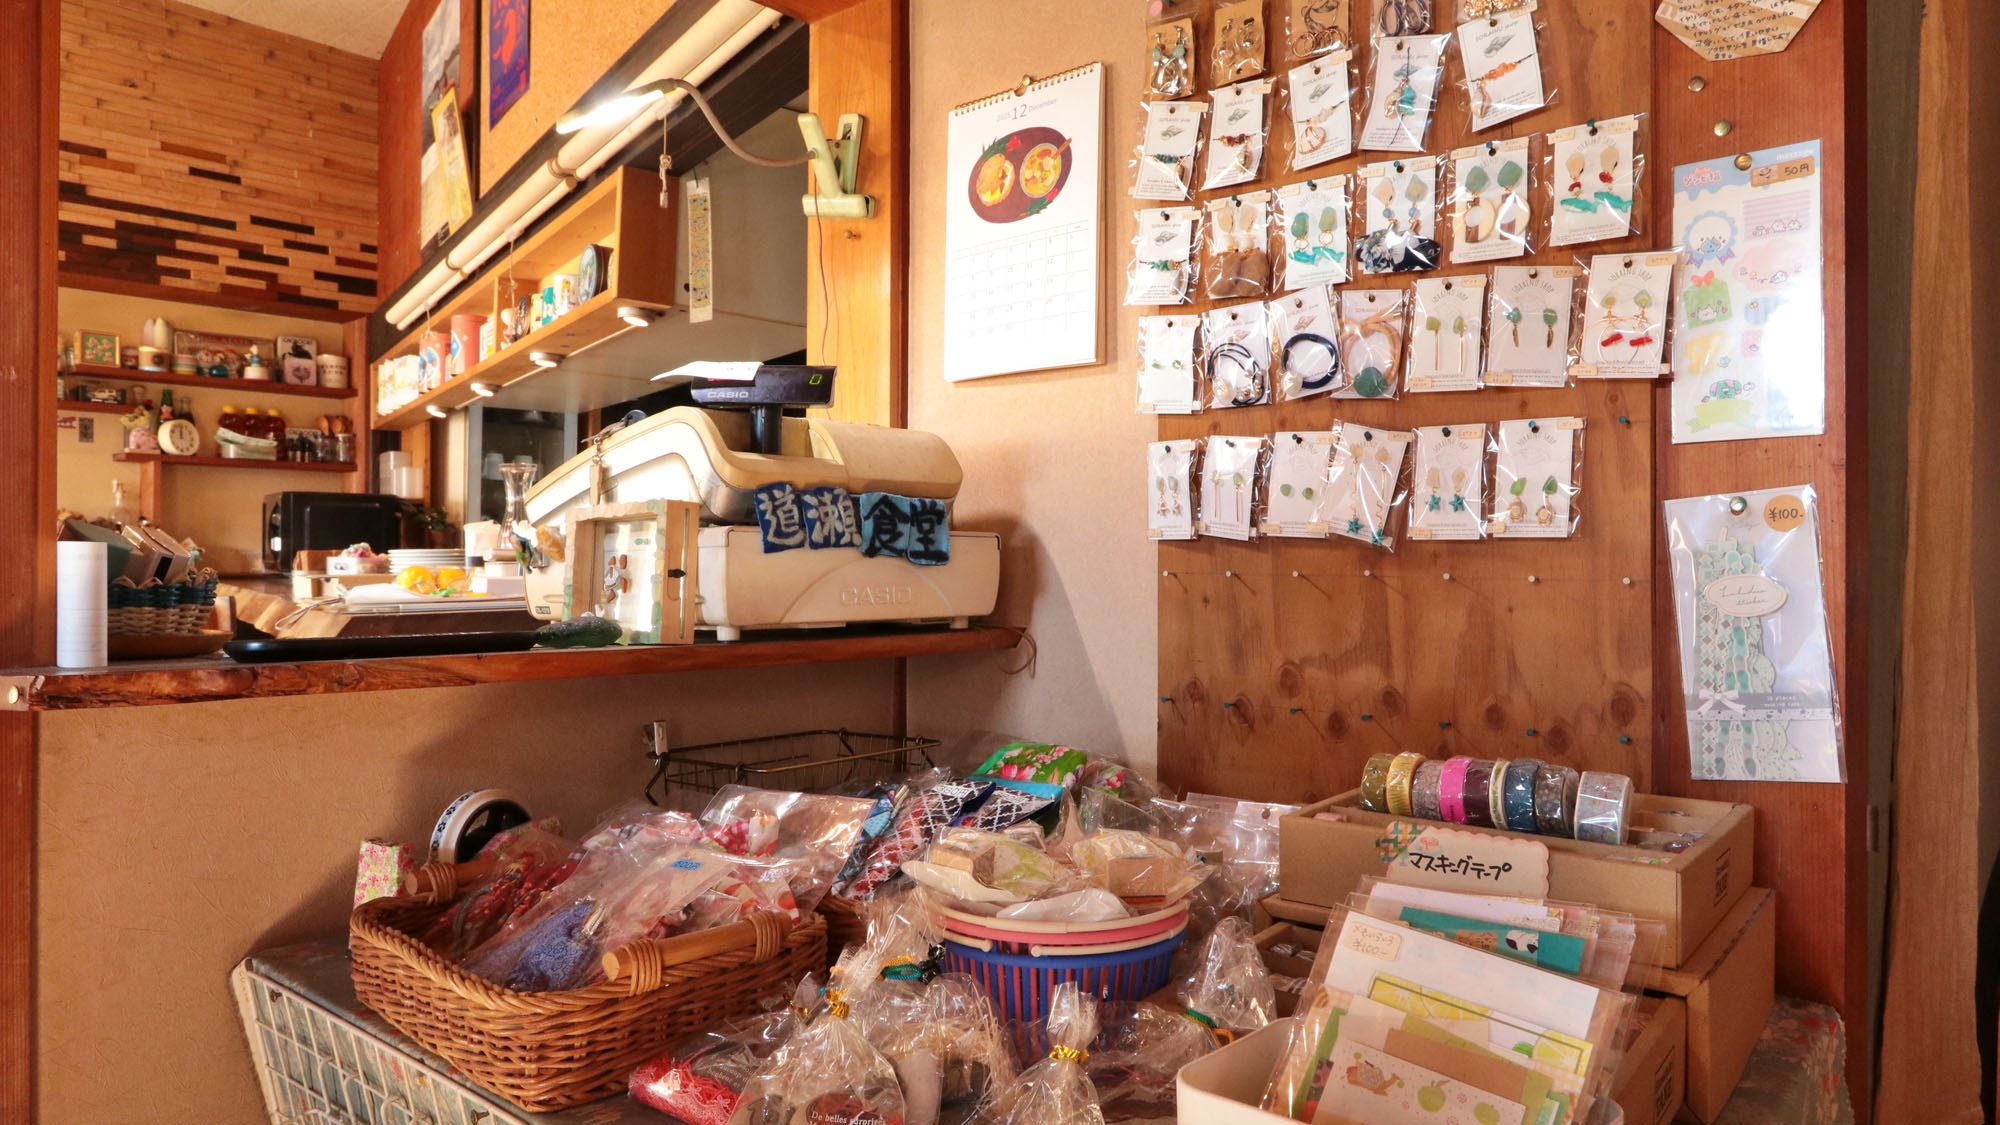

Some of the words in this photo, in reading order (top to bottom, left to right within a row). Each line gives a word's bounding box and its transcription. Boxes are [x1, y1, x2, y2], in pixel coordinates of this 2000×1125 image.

[1012, 103, 1028, 120] 12
[1784, 163, 1810, 177] 50円
[808, 373, 823, 385] 0
[707, 390, 749, 399] CASIO
[758, 484, 950, 564] 道瀬食堂
[841, 585, 913, 606] CASIO
[1409, 851, 1512, 880] マスキングテープ
[811, 1111, 823, 1120] De
[825, 1114, 848, 1124] belles
